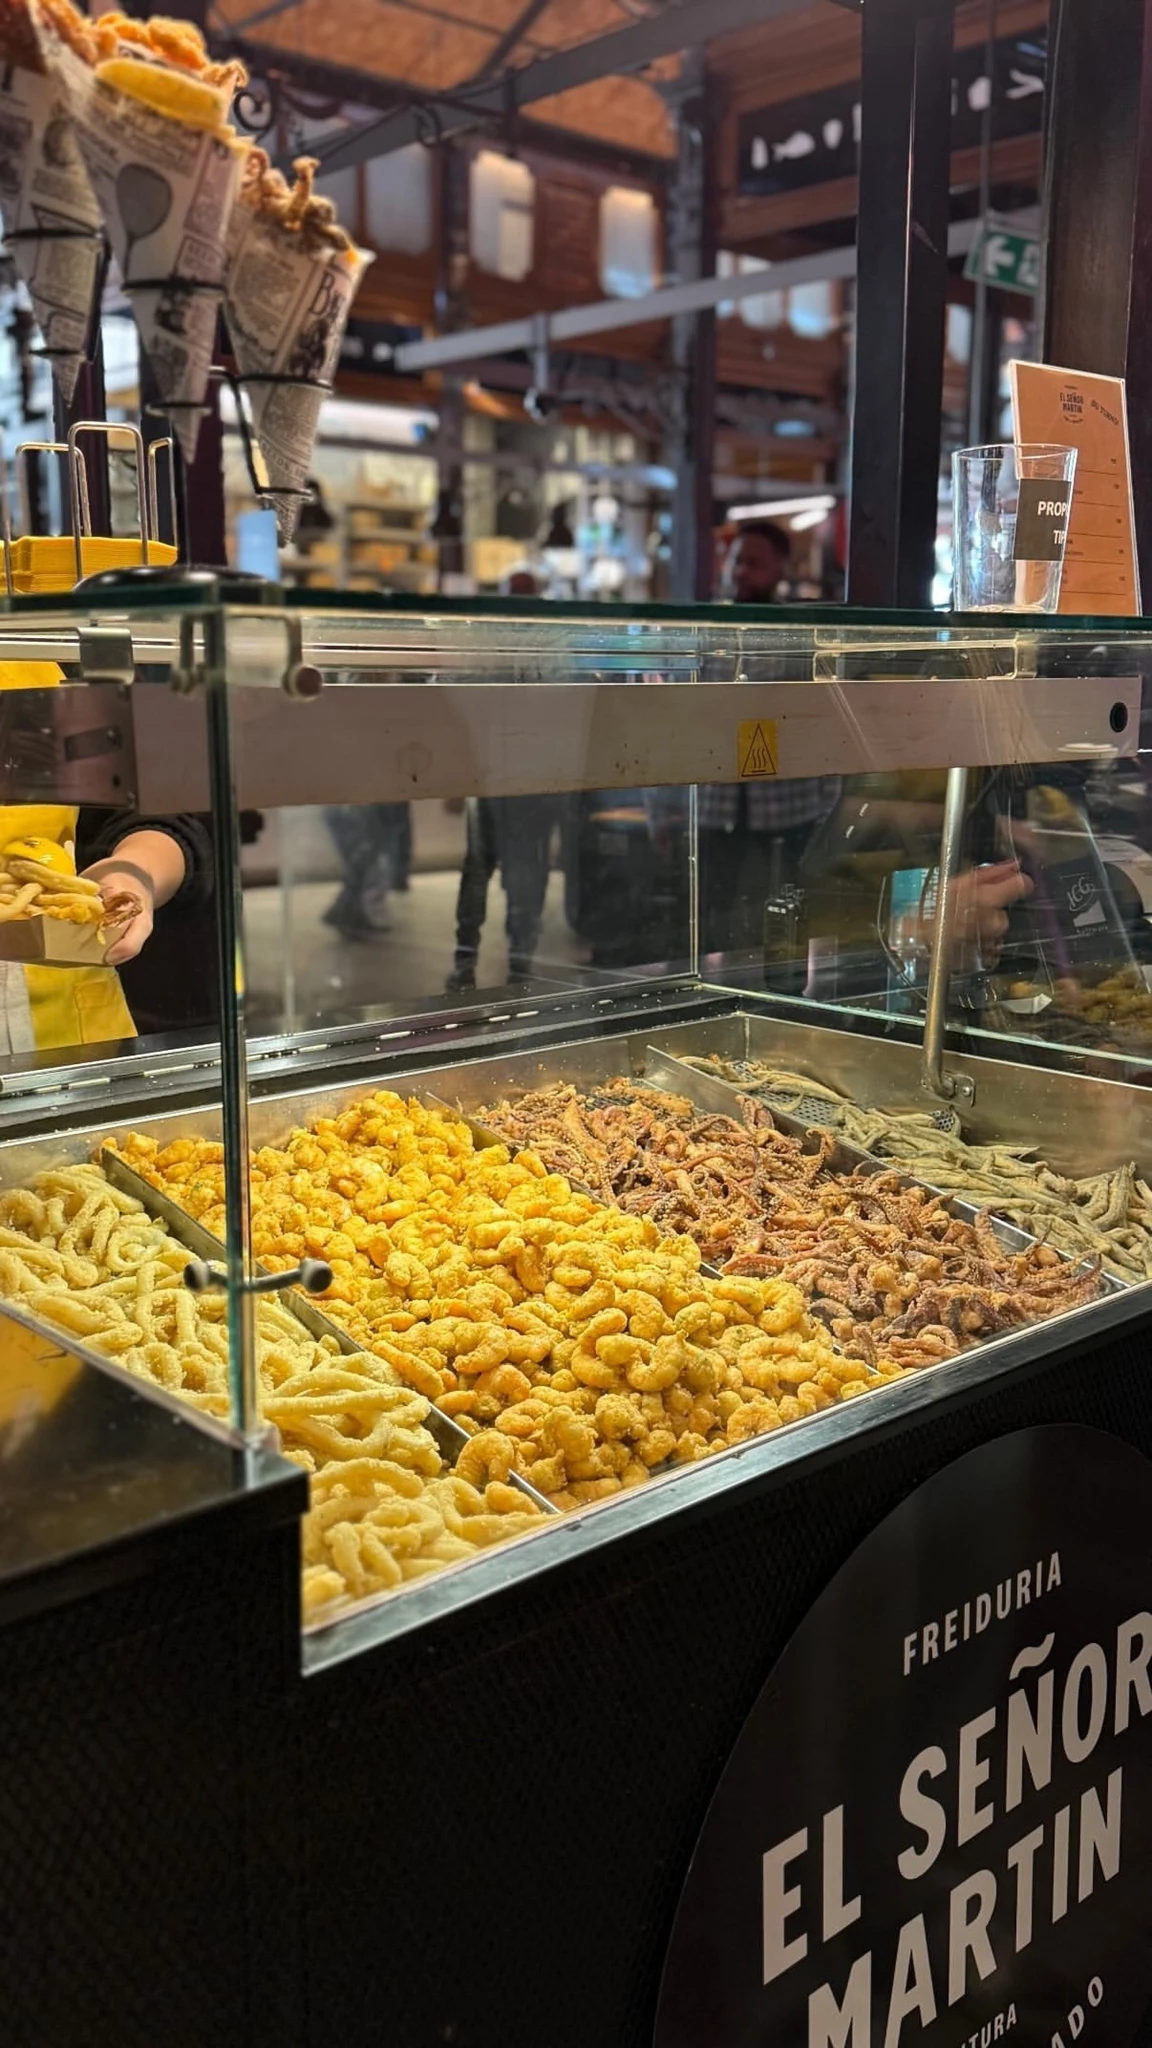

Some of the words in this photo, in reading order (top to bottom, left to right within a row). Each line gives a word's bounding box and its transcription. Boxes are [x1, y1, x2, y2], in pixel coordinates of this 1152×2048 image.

[903, 1551, 1062, 1677] FREIDURIA
[762, 1804, 862, 1986] EL
[898, 1611, 1152, 1880] SEÑOR
[808, 1766, 1123, 2048] MARTIN
[961, 2003, 1018, 2048] TURA
